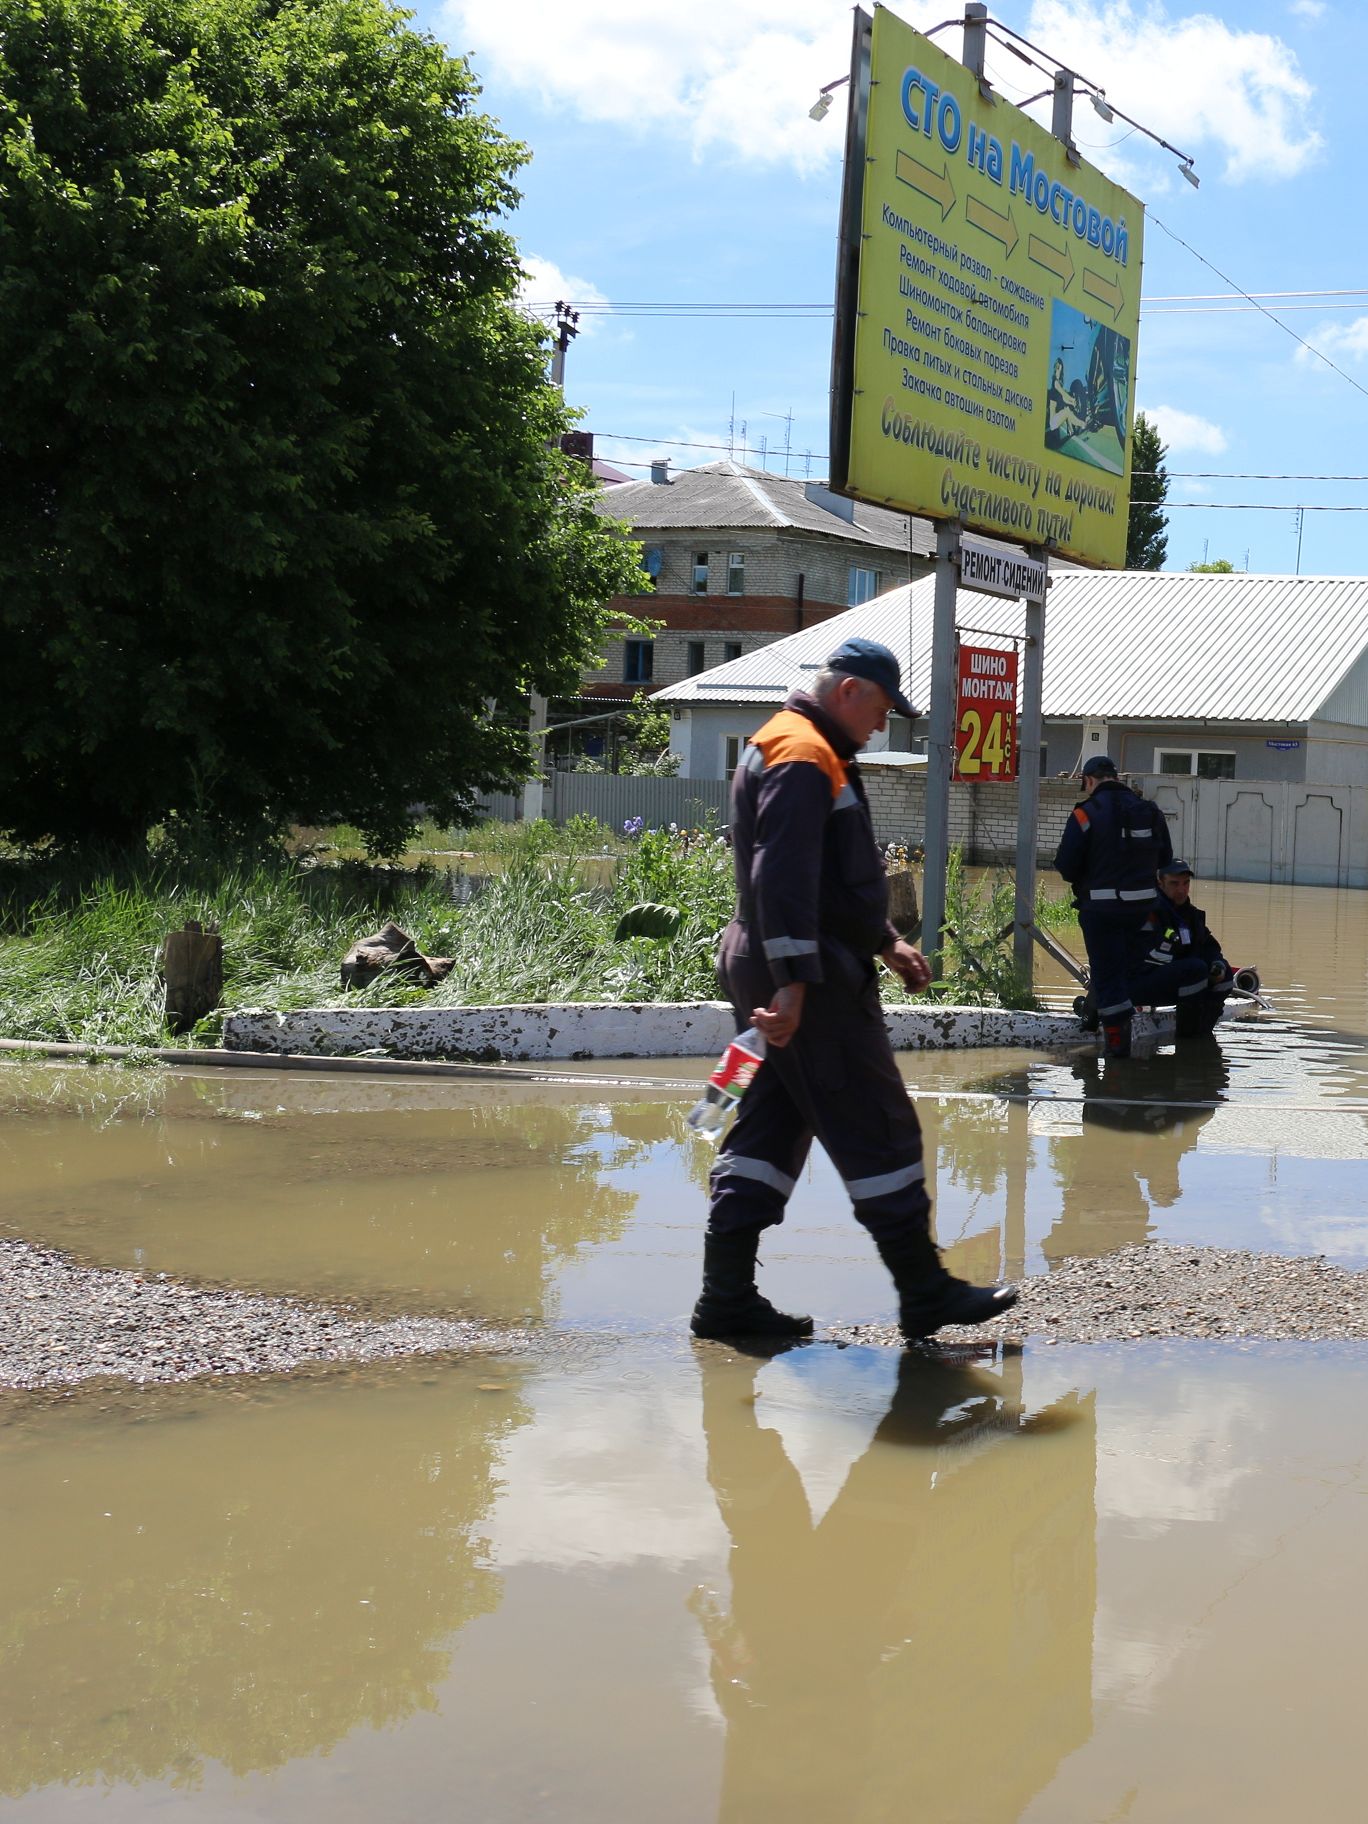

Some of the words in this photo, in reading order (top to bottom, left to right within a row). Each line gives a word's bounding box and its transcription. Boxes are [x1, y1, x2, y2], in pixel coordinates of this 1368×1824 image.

[901, 65, 961, 154] СТО
[967, 121, 1003, 185] на
[1009, 139, 1129, 266] Мостовой
[882, 203, 958, 262] Компьютерный
[960, 253, 991, 282] развал
[1000, 272, 1045, 311] схождение
[900, 244, 936, 277] Ремонт
[938, 268, 976, 300] ходовой
[978, 295, 1029, 327] автомобиля
[900, 275, 963, 323] Шиномонтаж
[965, 310, 1027, 354] балансировка
[906, 309, 941, 341] Ремонт
[944, 327, 981, 360] боковых
[984, 352, 1019, 379] порезов
[883, 328, 920, 360] Правка
[923, 352, 951, 376] литых
[953, 366, 960, 379] и
[962, 368, 1002, 401] стальных
[1004, 388, 1033, 412] дисков
[901, 368, 942, 401] Закачка
[944, 390, 983, 421] автошин
[986, 408, 1015, 432] азотом
[881, 395, 980, 469] Соблюдайте
[986, 447, 1040, 499] чистоту
[1045, 469, 1061, 497] на
[1064, 476, 1116, 515] дорогах!
[940, 467, 1032, 531] Счастливого
[1036, 509, 1073, 543] пути!
[964, 549, 1001, 584] РЕМОНТ
[1003, 560, 1043, 596] СИДЕНИЙ
[962, 678, 1014, 700] МОНТАЖ
[971, 654, 1007, 676] ШИНО
[958, 710, 1004, 774] 24
